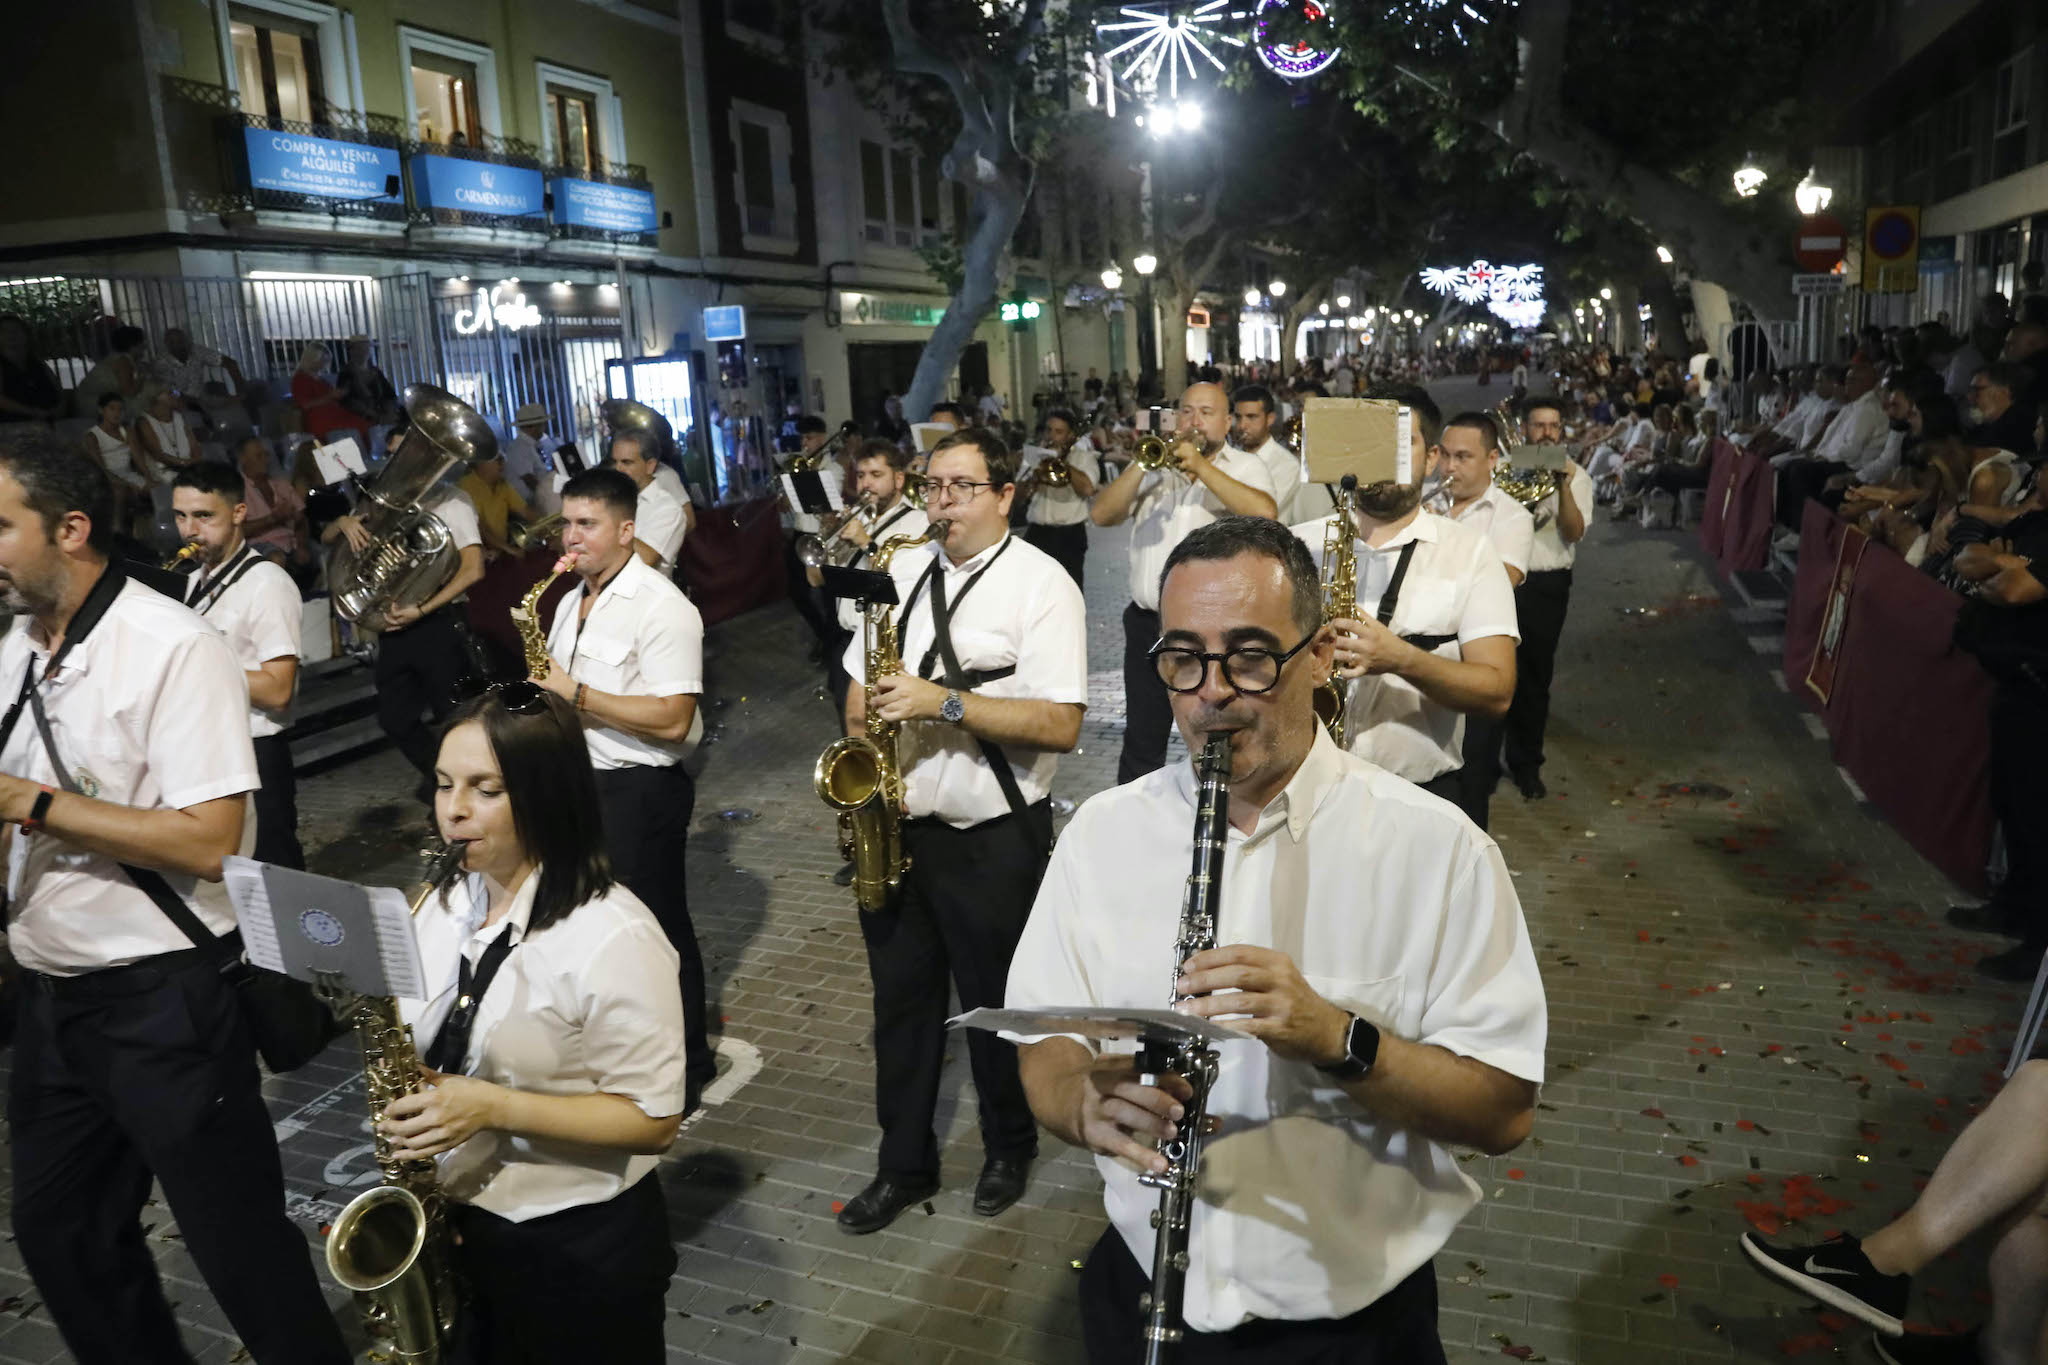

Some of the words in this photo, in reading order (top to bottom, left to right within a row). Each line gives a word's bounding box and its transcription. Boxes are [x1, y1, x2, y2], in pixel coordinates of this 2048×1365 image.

[272, 137, 326, 157] COMPRA
[341, 148, 380, 164] VENTA
[302, 156, 357, 174] ALQUILER
